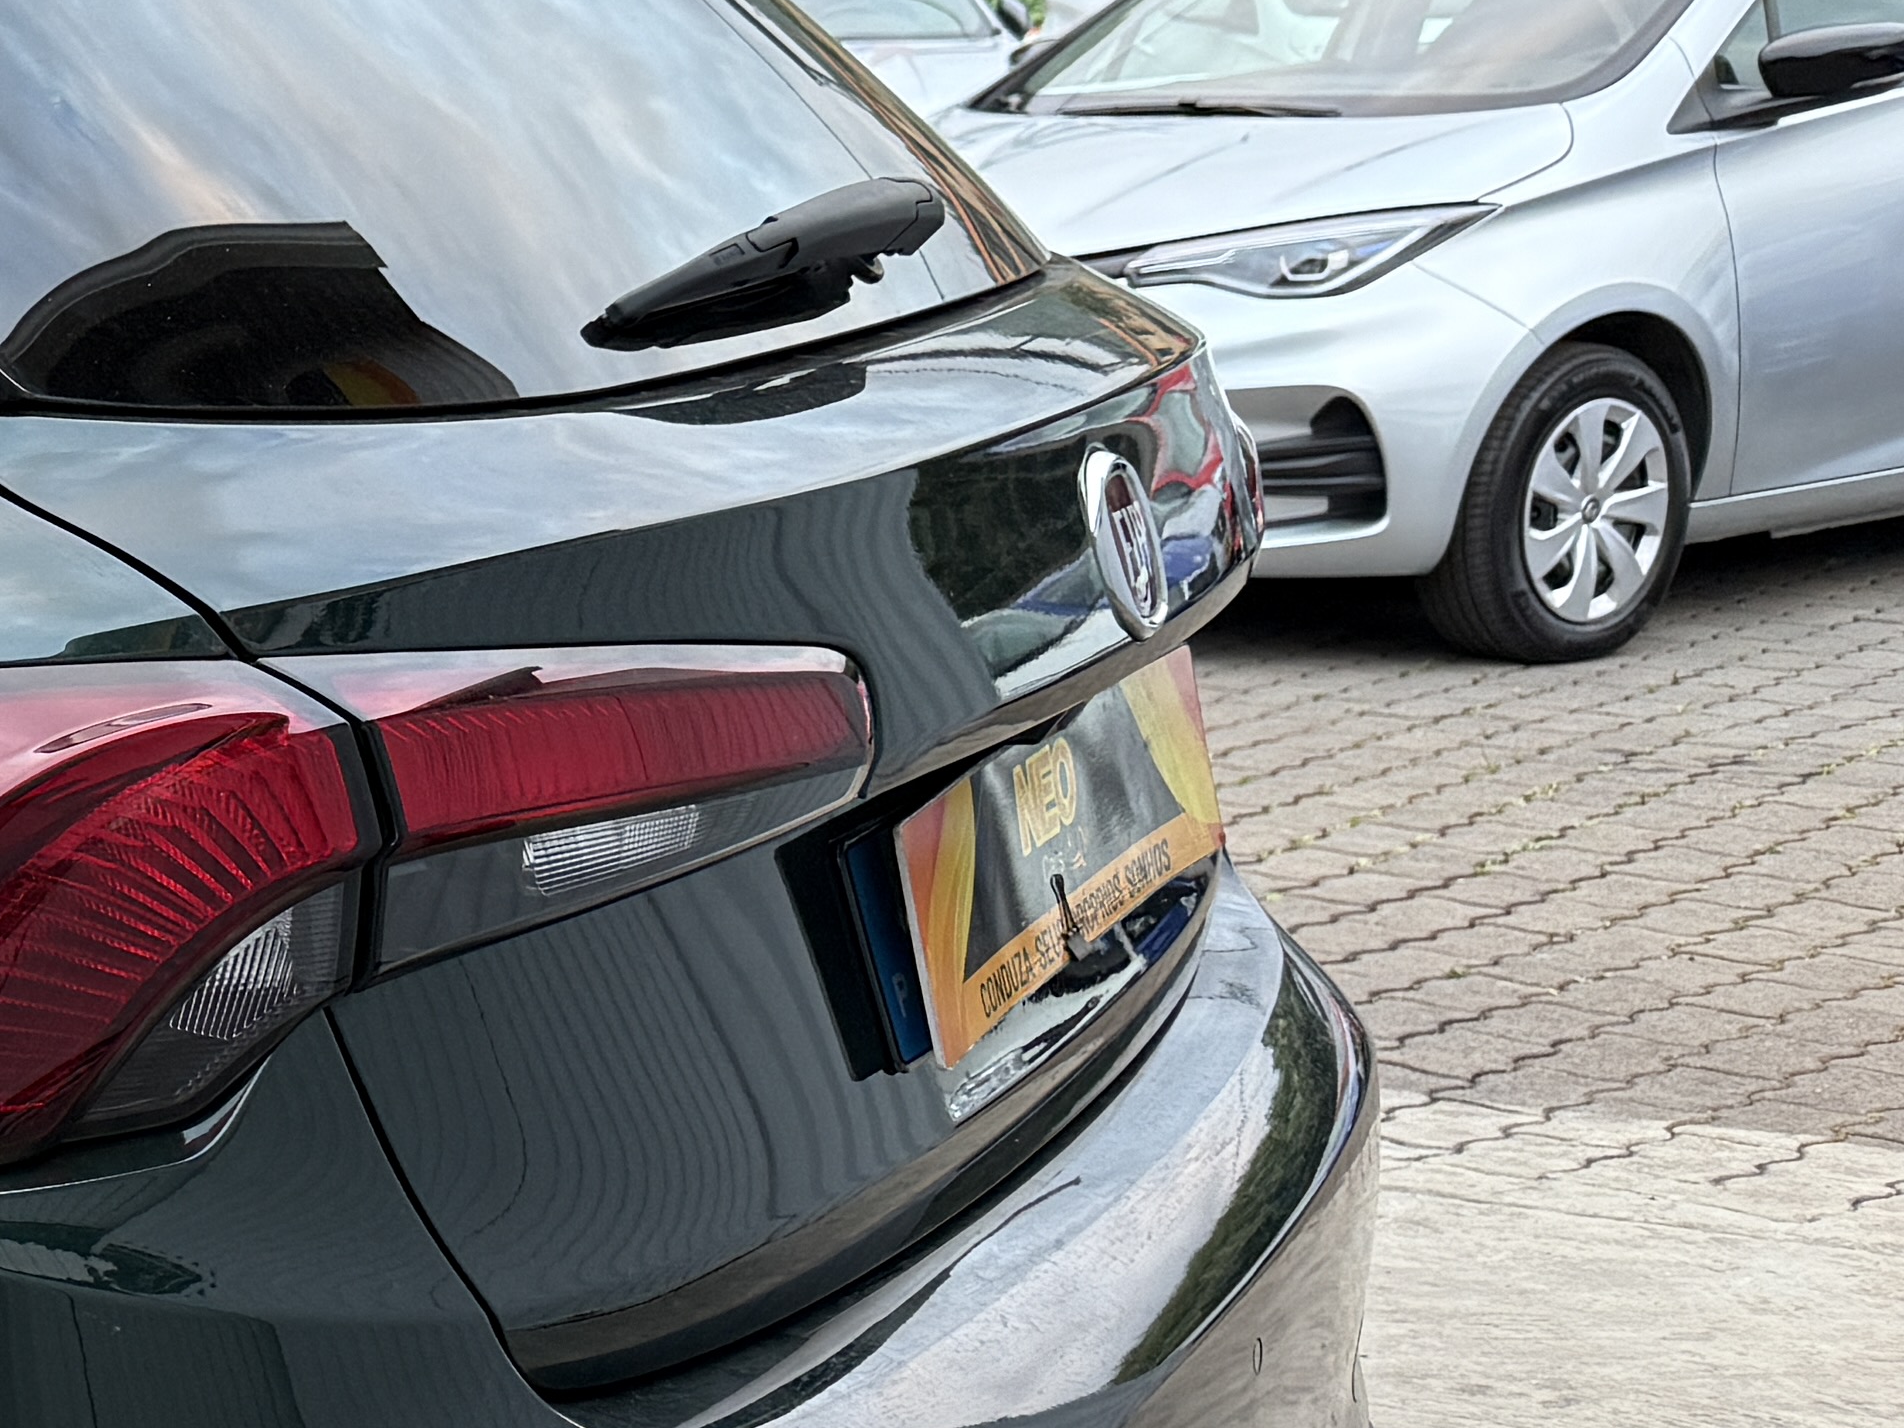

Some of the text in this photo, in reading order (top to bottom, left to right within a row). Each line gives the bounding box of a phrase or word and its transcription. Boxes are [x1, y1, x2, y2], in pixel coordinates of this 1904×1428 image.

[1012, 736, 1078, 858] NEO
[979, 946, 1036, 1019] CONDUZA
[1035, 917, 1068, 970] SEU
